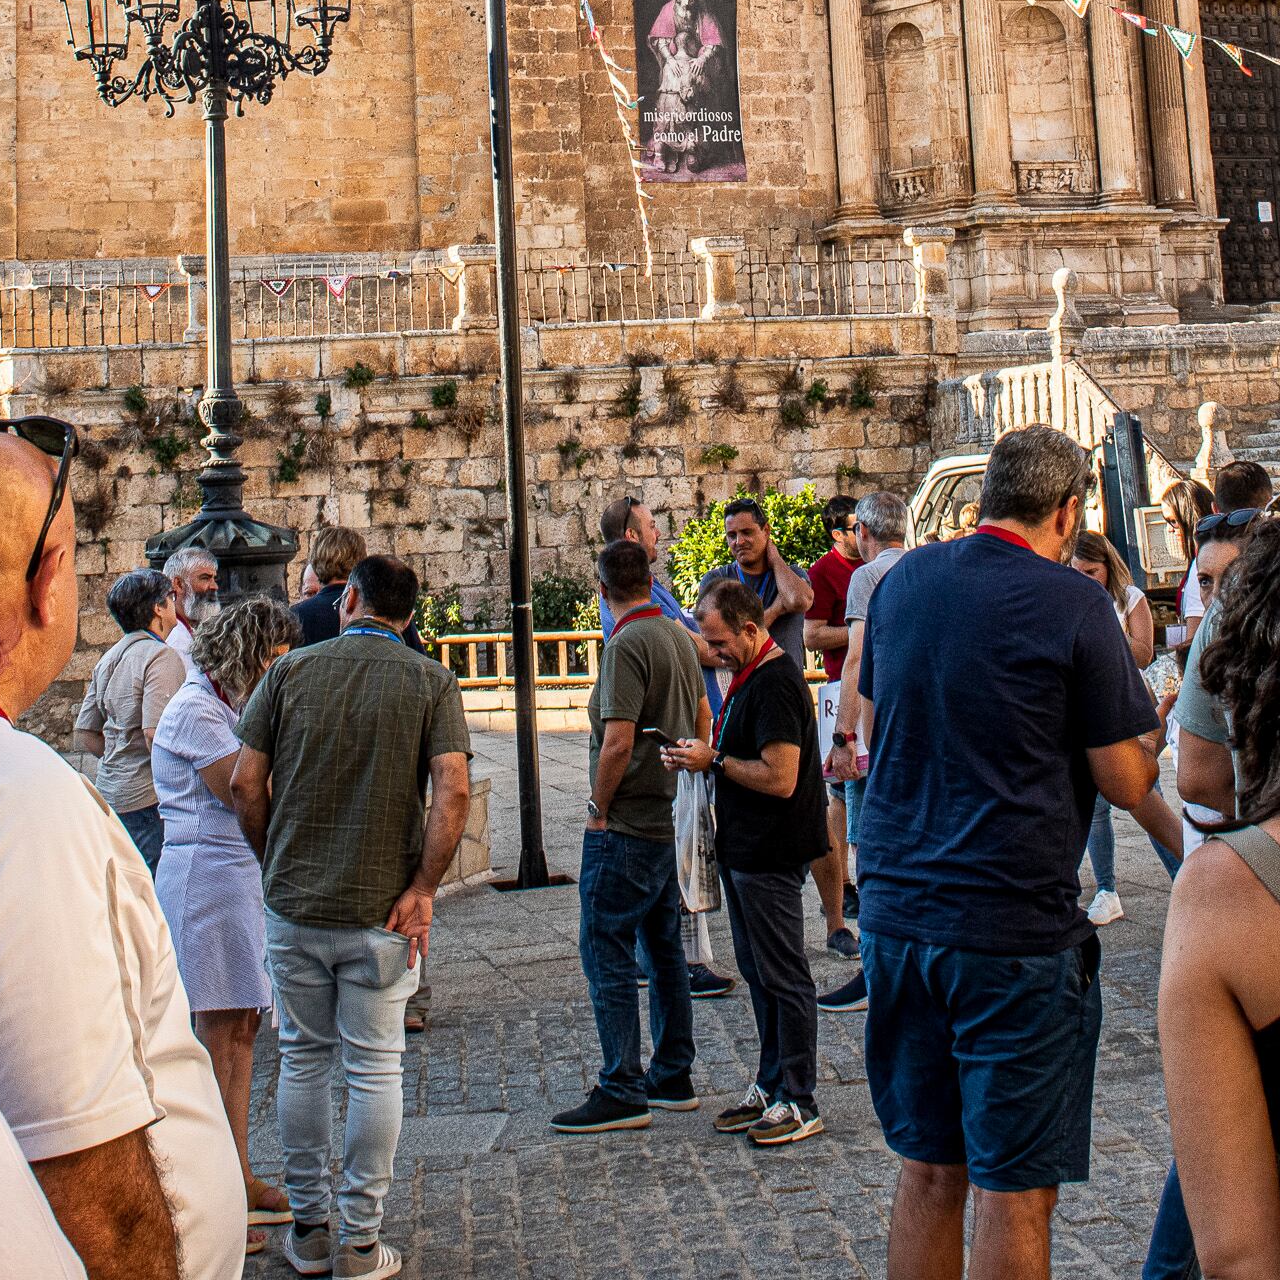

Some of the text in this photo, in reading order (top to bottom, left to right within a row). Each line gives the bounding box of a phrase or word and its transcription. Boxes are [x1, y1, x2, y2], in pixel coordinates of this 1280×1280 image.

[644, 108, 733, 122] misericordiosos
[654, 125, 741, 143] como el Padre
